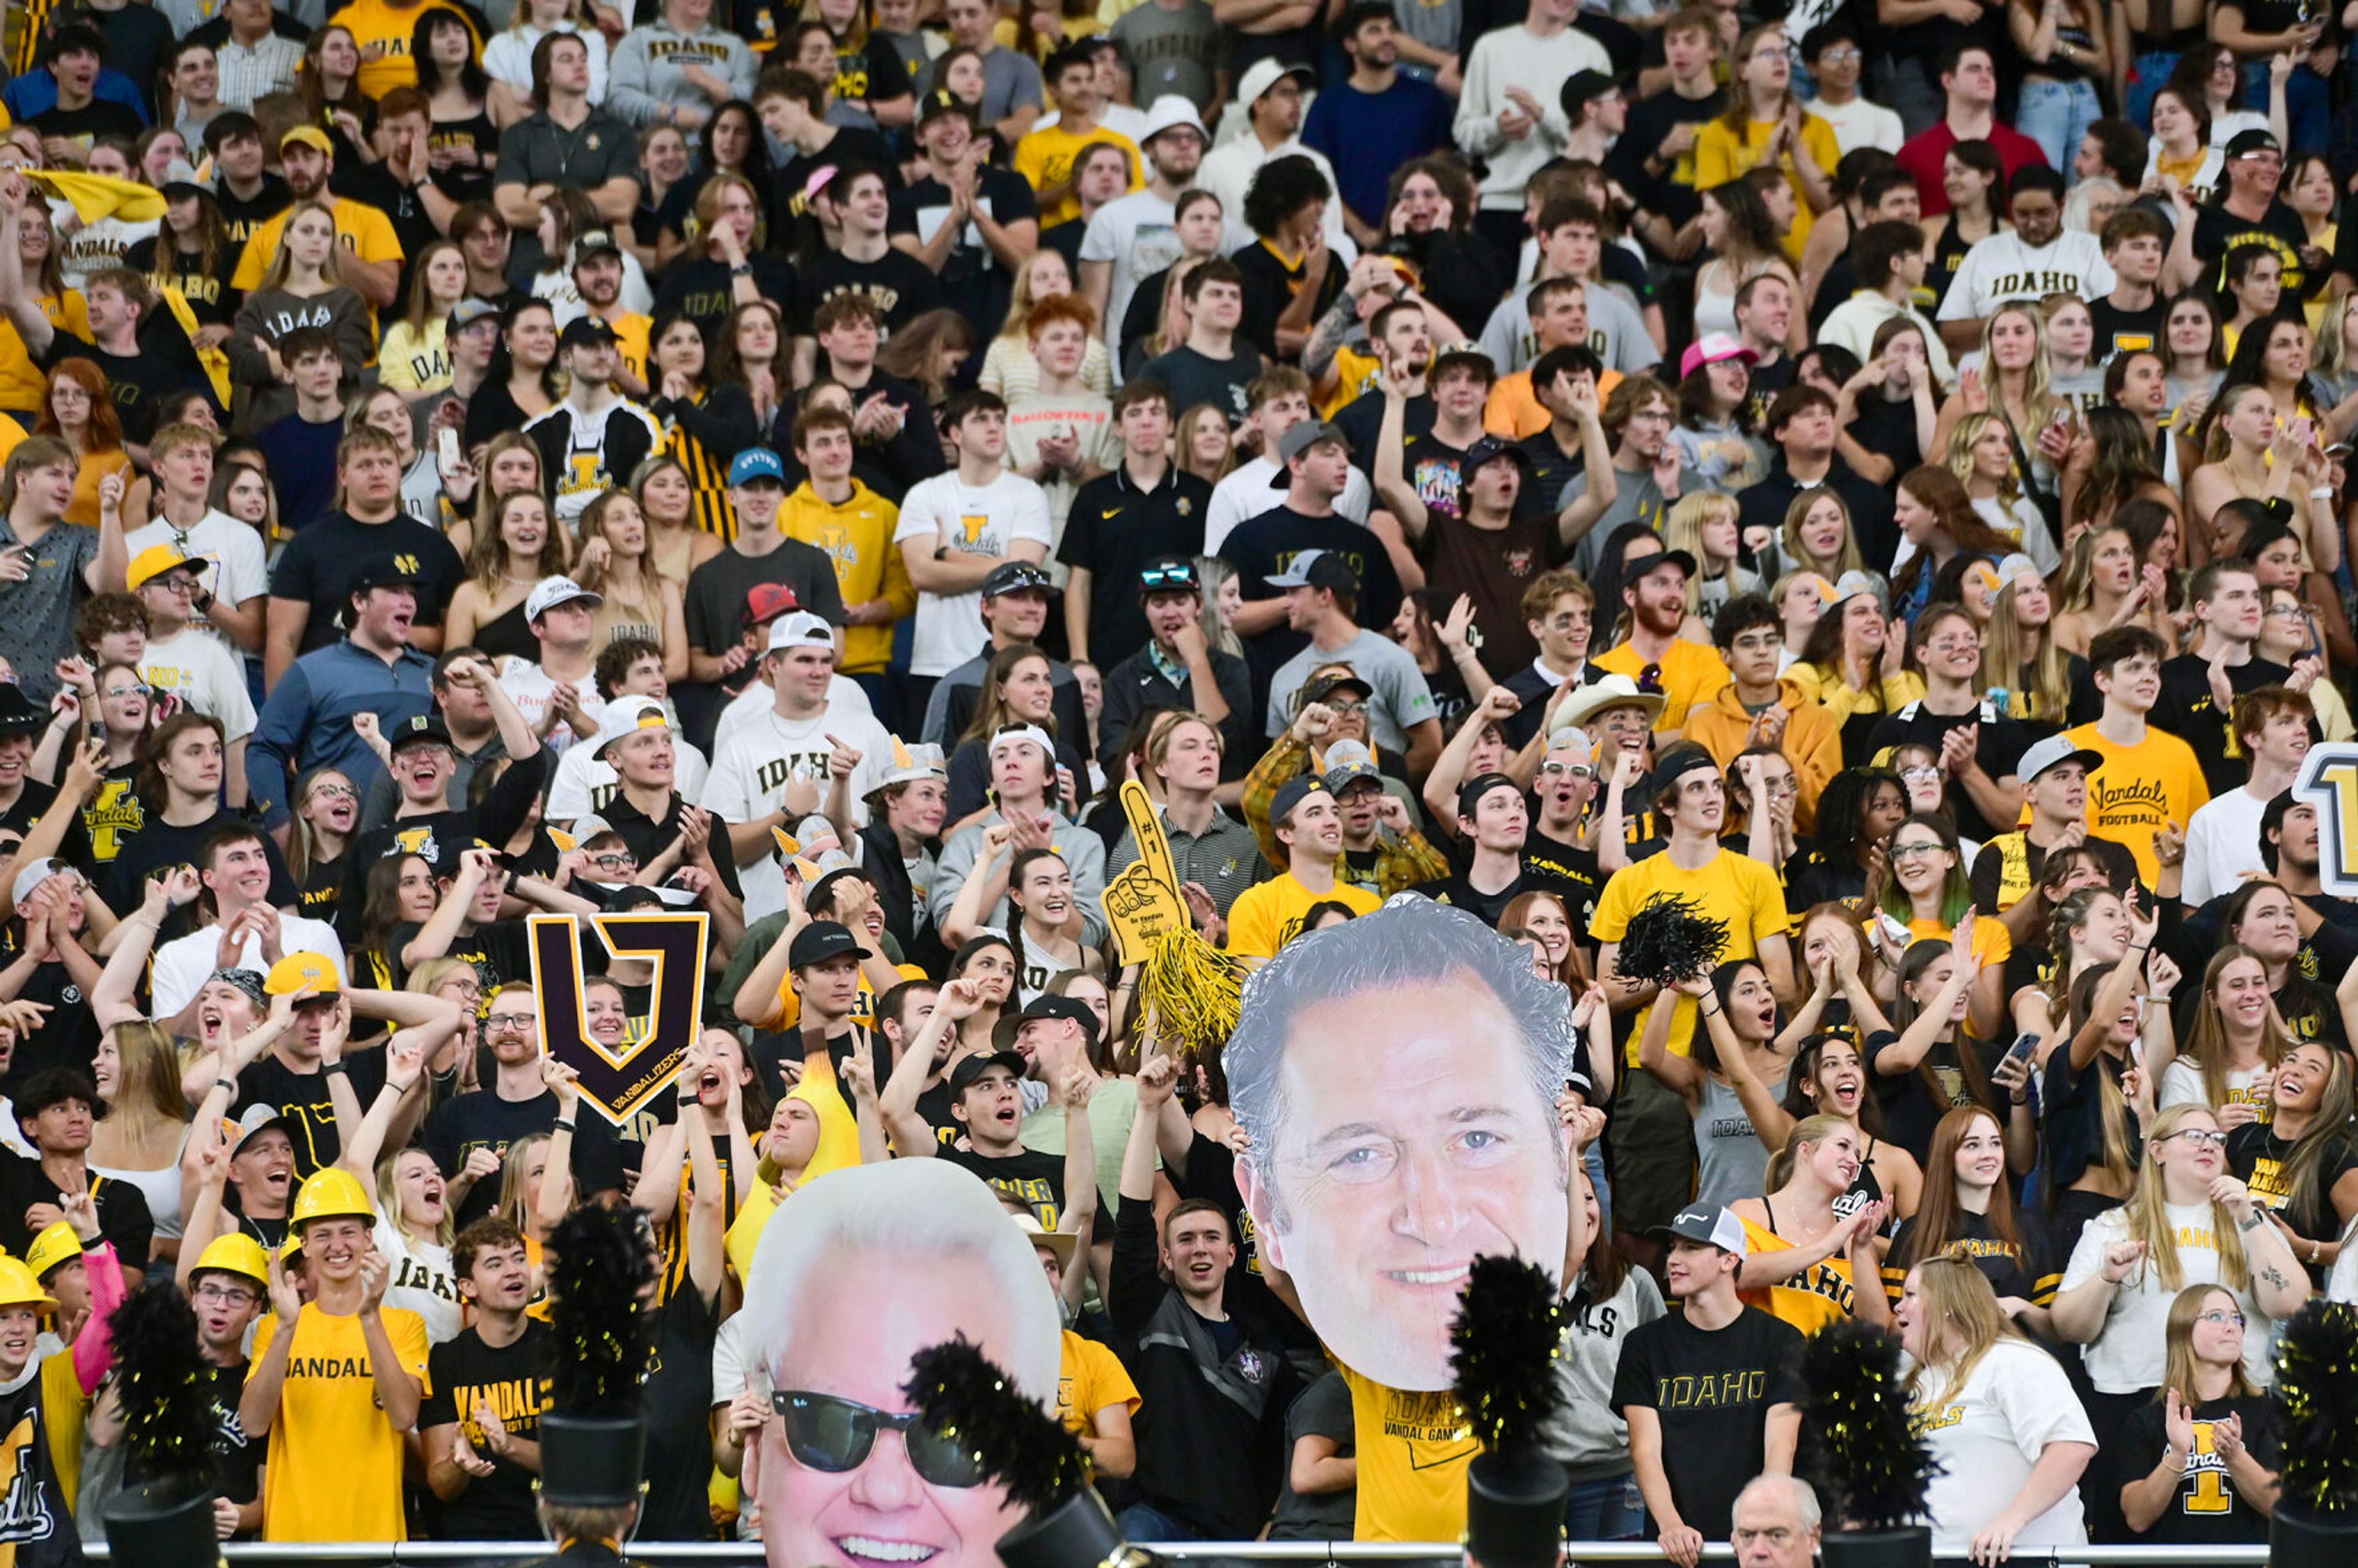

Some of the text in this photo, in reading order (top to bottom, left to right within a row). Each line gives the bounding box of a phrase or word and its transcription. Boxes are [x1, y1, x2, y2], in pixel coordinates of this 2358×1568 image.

[63, 238, 128, 259] ANDALS
[1991, 271, 2079, 297] IDAHO
[683, 290, 736, 316] IDA
[2090, 777, 2167, 815] Vandals
[2098, 815, 2161, 827] FOOTBALL
[611, 1047, 681, 1110] VANDALIZERS
[1712, 1119, 1756, 1138] IDA
[284, 1358, 374, 1378] ANDAL
[1657, 1369, 1767, 1409] IDAHO
[1385, 1422, 1425, 1440] VANDAL
